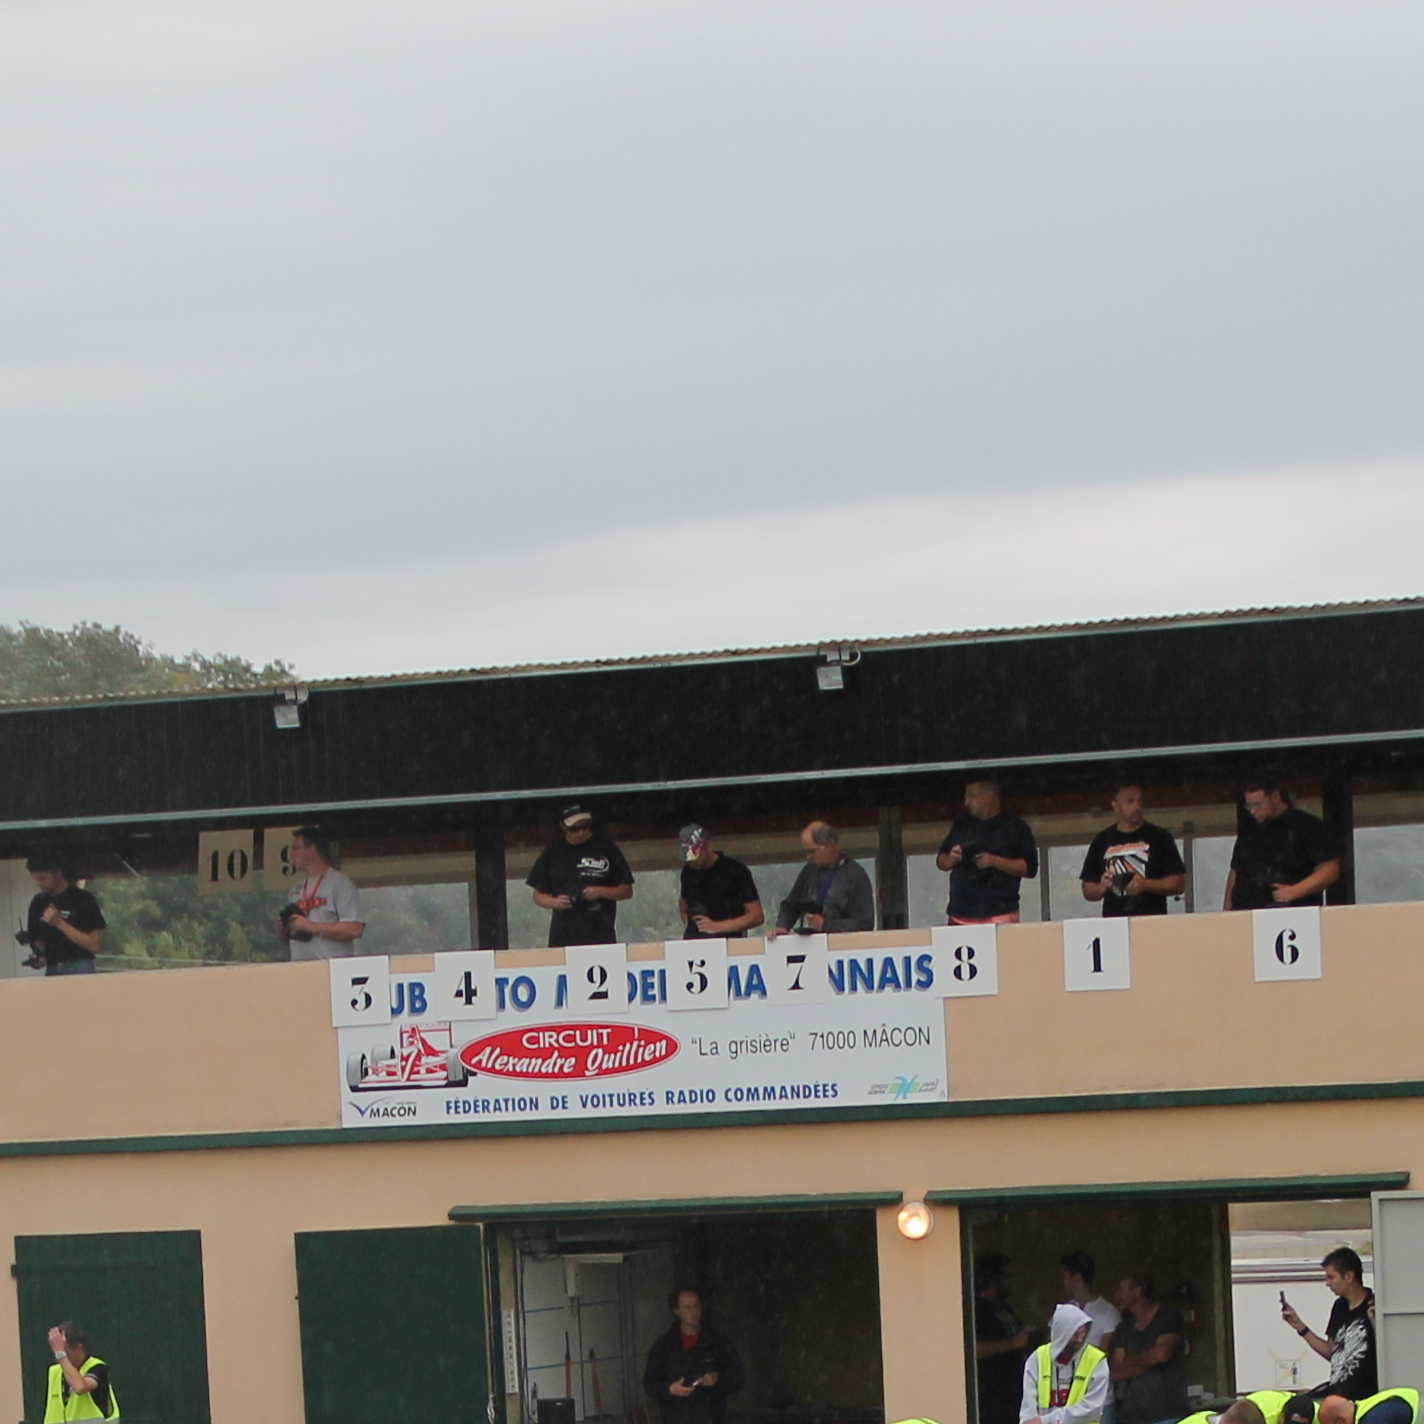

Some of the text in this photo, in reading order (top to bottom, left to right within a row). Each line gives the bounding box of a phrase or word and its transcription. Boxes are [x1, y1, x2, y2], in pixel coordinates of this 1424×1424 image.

[210, 849, 249, 882] 10
[953, 945, 978, 982] 8
[1085, 936, 1105, 974] 1
[1274, 928, 1300, 966] 6
[453, 970, 478, 1006] 4
[586, 964, 609, 1001] 2
[685, 959, 709, 995] 5
[786, 954, 808, 991] 7
[350, 975, 373, 1013] 3
[495, 974, 537, 1012] TO
[521, 1028, 612, 1049] CIRCUIT
[808, 1030, 857, 1051] 71000
[863, 1023, 931, 1049] MÂCON
[471, 1038, 668, 1076] Alexandre Quillien
[550, 1095, 569, 1110] DE
[579, 1090, 656, 1109] VOITURES
[665, 1087, 716, 1105] RADIO
